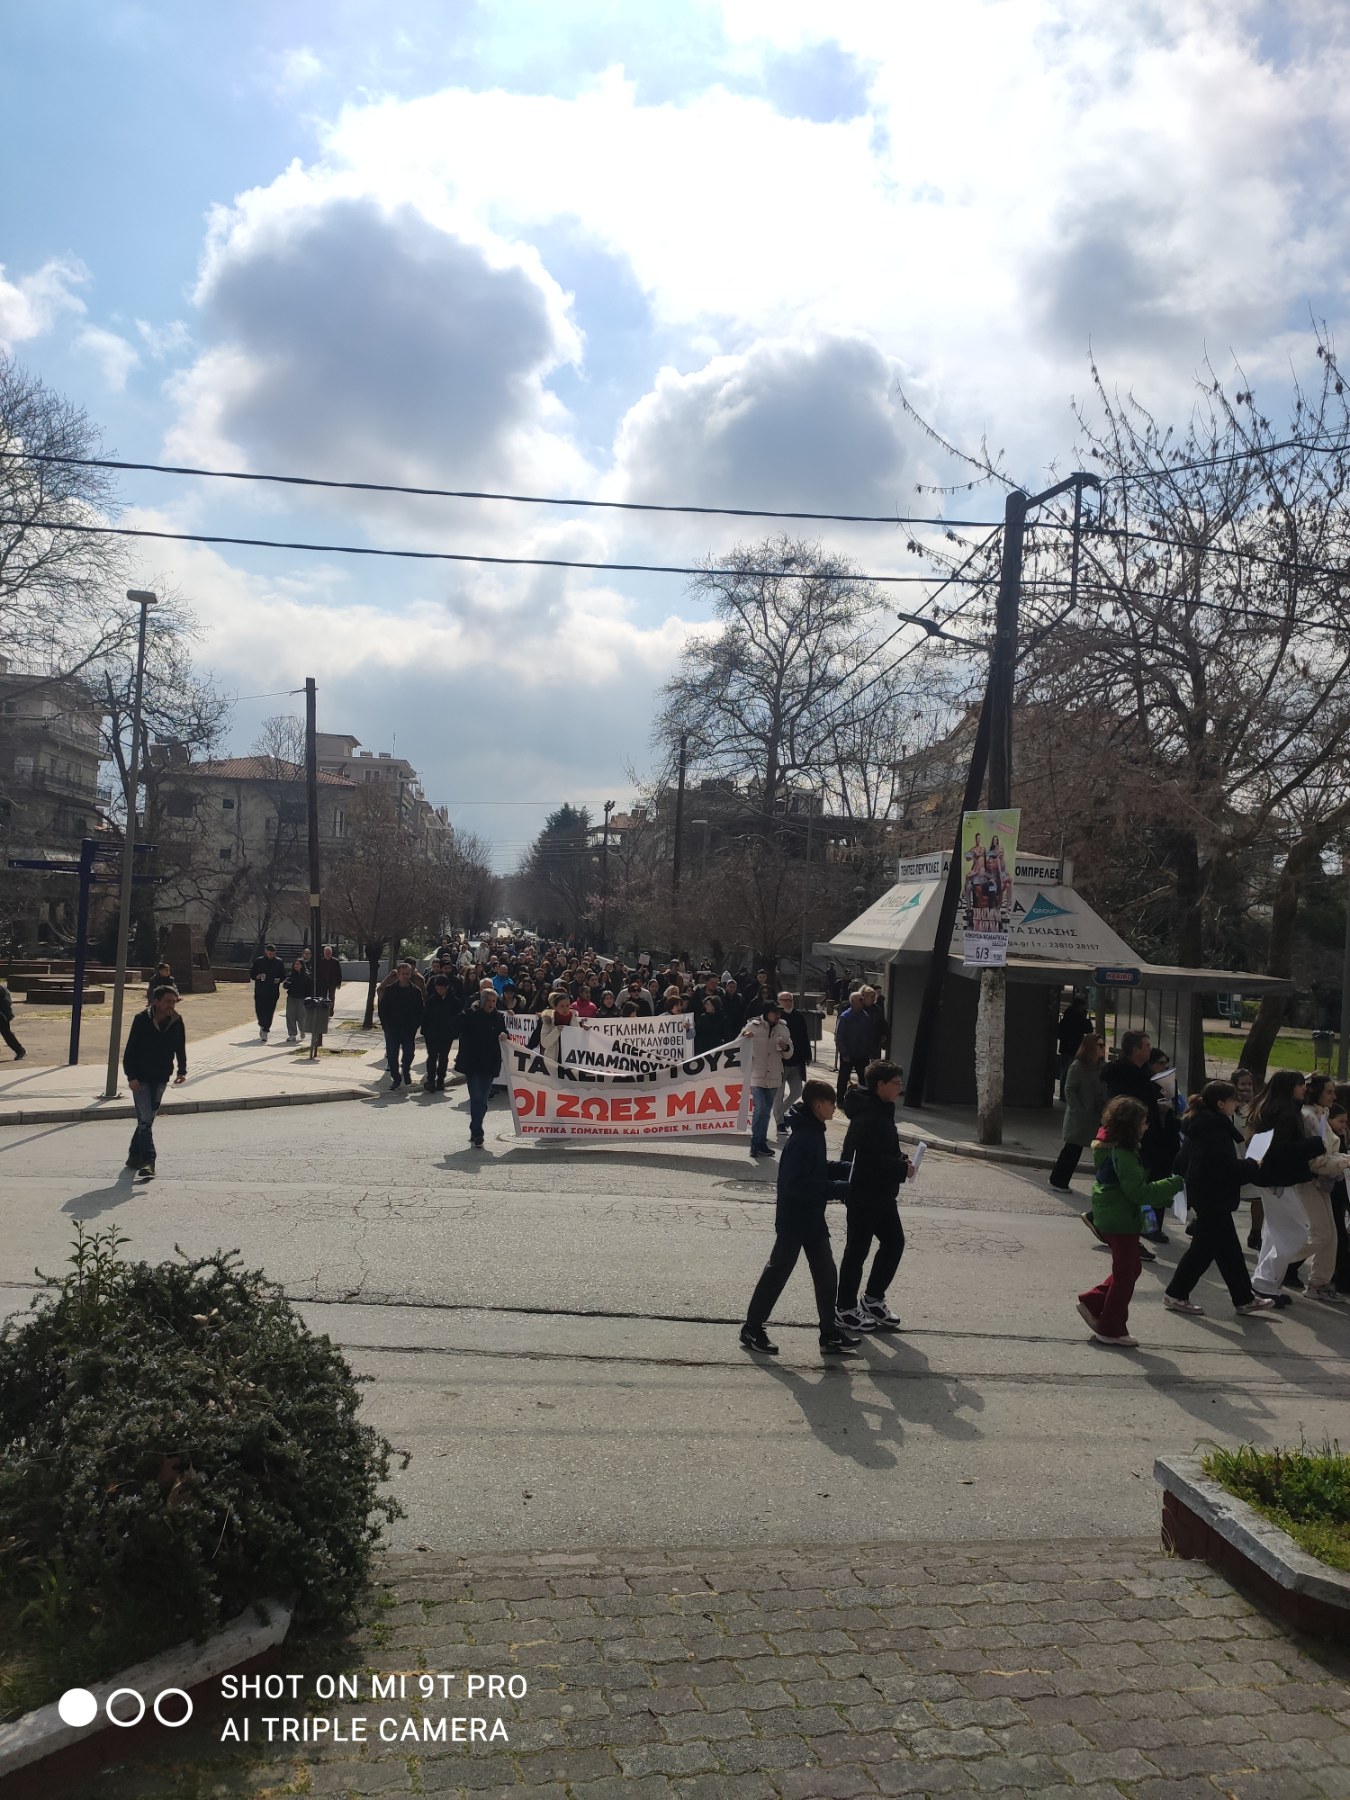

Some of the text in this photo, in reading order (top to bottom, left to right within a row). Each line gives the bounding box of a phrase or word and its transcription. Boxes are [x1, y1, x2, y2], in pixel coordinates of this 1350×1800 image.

[1015, 866, 1060, 879] ΟΜΠΡΕΛΕΣ
[1028, 926, 1078, 937] ΣΚΙΑΣΗΣ
[975, 946, 990, 960] 6/3
[603, 1022, 655, 1037] ΕΓΚΛΗΜΑ
[513, 1050, 551, 1077] ΤΑ
[565, 1048, 675, 1074] ΔΥΝΑΜΩΝΟΥ
[513, 1088, 546, 1117] ΟΙ
[556, 1093, 656, 1121] ΖΩΕΣ
[666, 1084, 743, 1117] ΜΑΣ
[522, 1125, 567, 1135] ΕΡΓΑΤΙΚΑ
[570, 1126, 619, 1135] ΣΩΜΑΤΕΙΑ
[622, 1127, 640, 1135] ΚΑΙ
[643, 1125, 679, 1134] ΦΟΡΕΙΣ
[695, 1120, 735, 1130] ΠΕΛΛΑΣ
